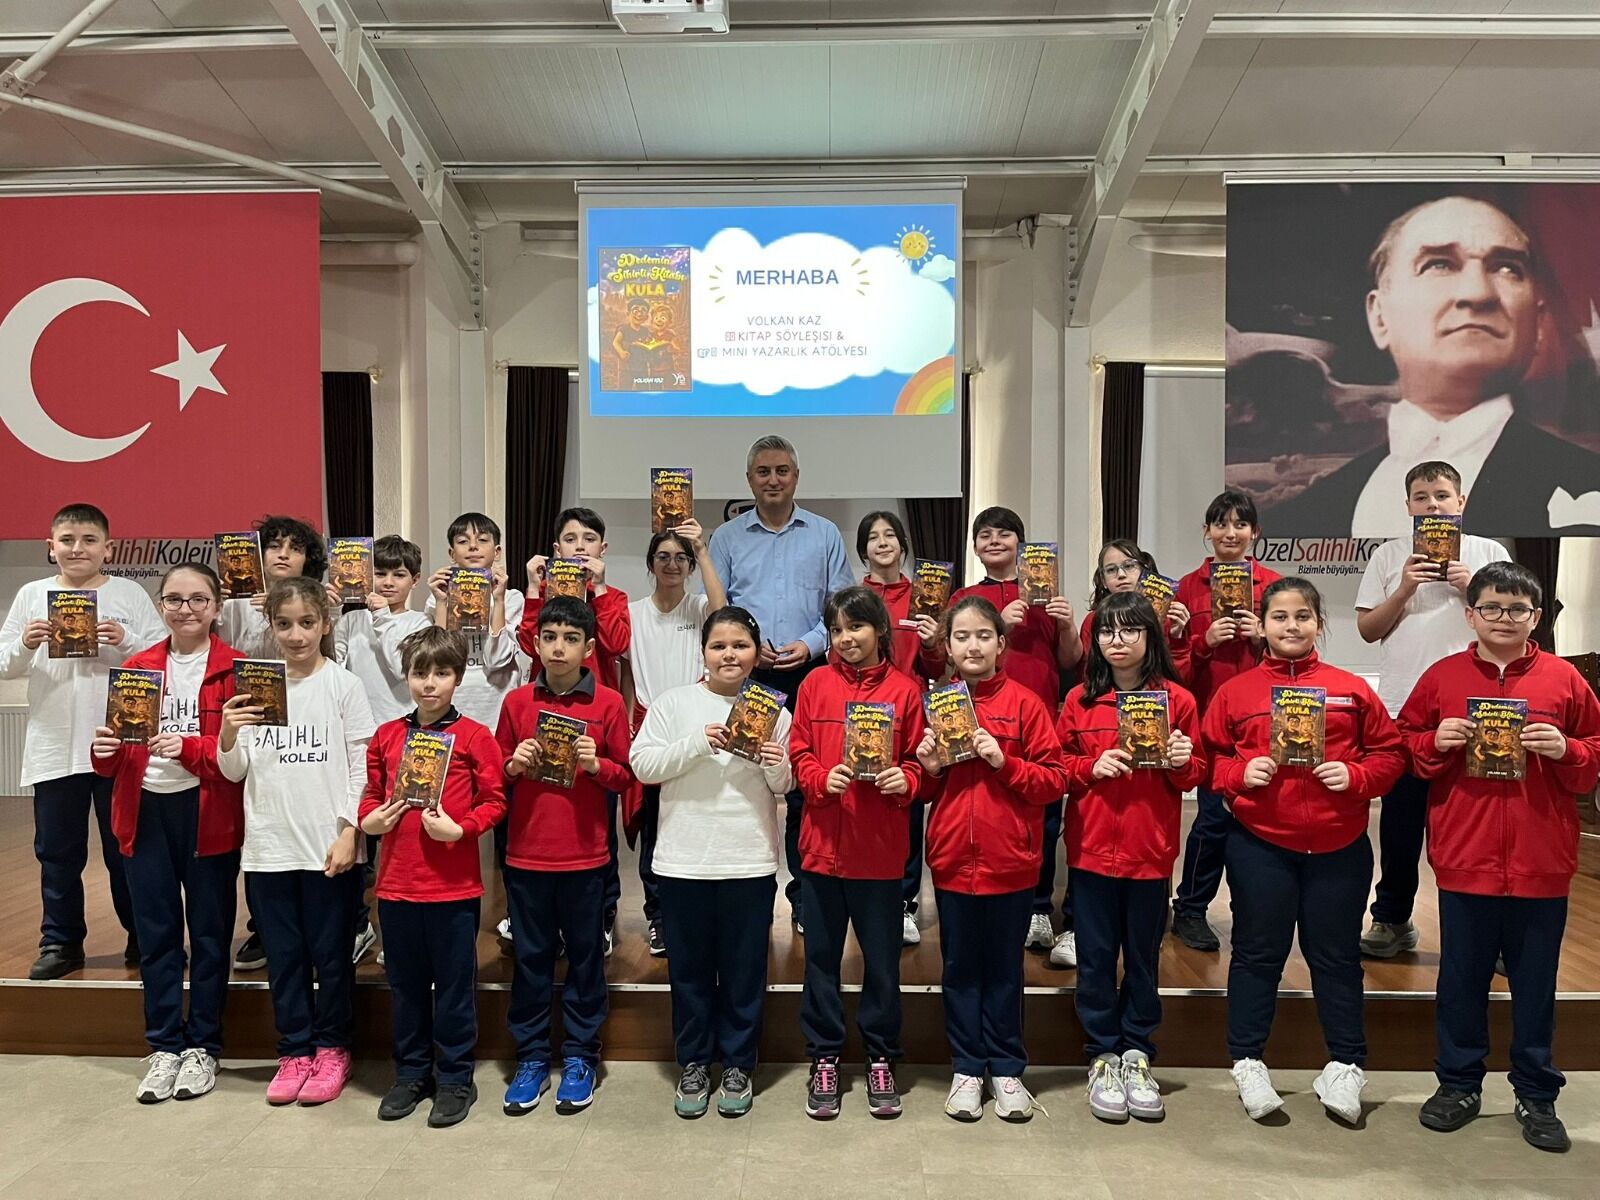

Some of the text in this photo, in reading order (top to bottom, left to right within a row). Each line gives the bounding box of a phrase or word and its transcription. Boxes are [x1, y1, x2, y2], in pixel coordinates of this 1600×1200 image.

[736, 269, 839, 285] MERHABA
[625, 283, 665, 296] KULA
[747, 315, 821, 326] VOLKAN KAZ
[837, 331, 844, 341] &
[752, 346, 808, 357] YAZARLIK
[1426, 531, 1448, 539] KULA
[99, 568, 124, 577] izimle
[1298, 565, 1325, 574] Bizimle
[122, 688, 146, 697] KULA
[748, 700, 768, 714] KULA
[938, 702, 959, 716] KULA
[1286, 706, 1310, 715] KULA
[1131, 711, 1154, 719] KULA
[161, 723, 200, 733] KOLE
[857, 721, 880, 729] KULA
[1483, 719, 1510, 728] KULA
[414, 748, 435, 757] KULA
